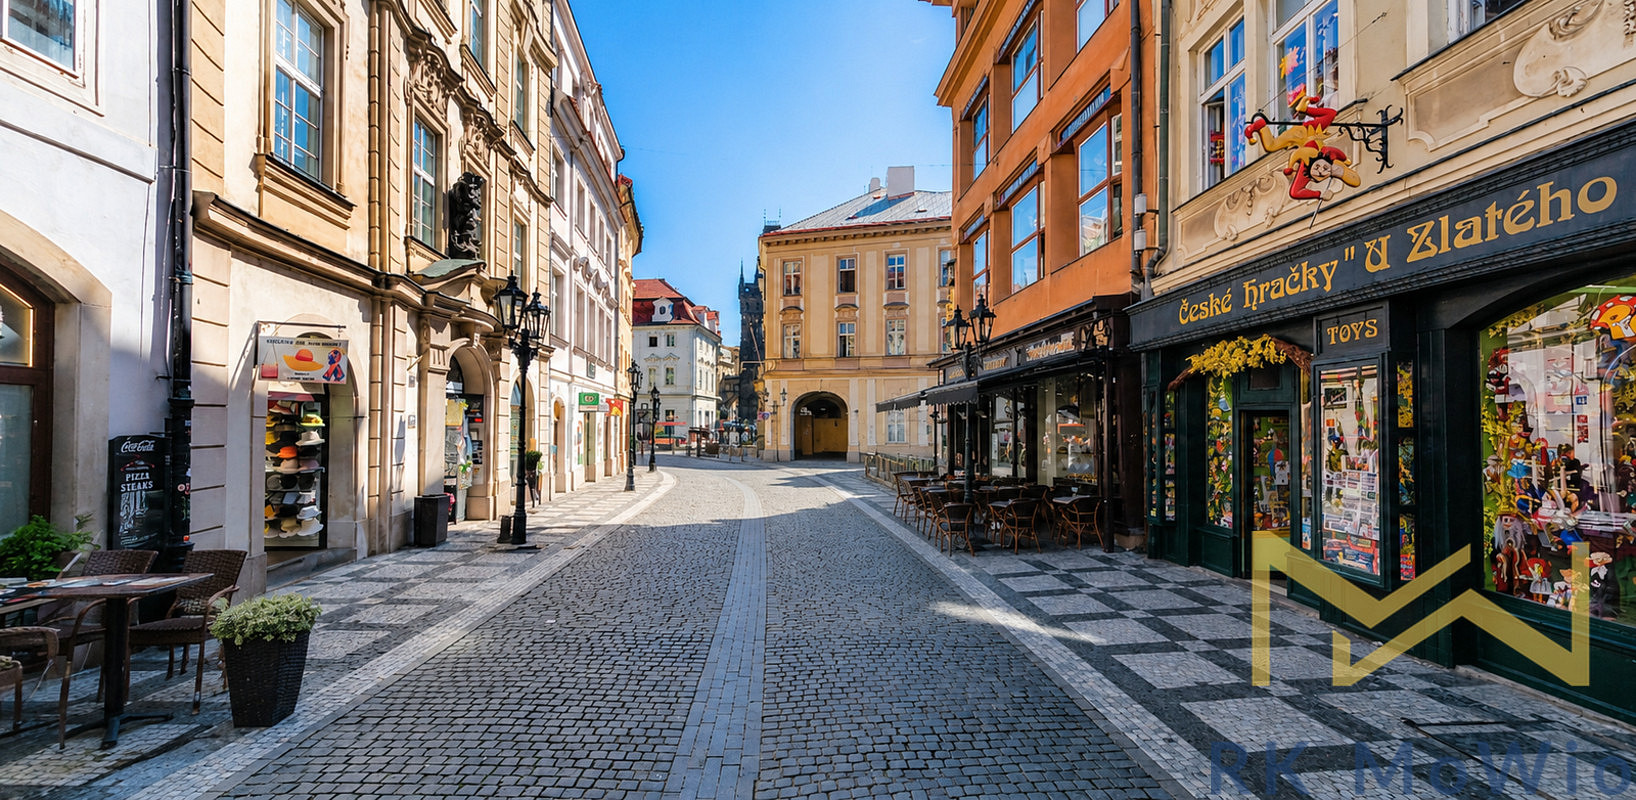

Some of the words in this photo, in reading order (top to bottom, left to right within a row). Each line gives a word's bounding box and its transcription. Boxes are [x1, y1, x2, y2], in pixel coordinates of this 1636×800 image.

[1178, 288, 1232, 325] České
[1406, 175, 1618, 263] Zlatého
[1326, 318, 1378, 345] TOYS
[120, 481, 154, 492] STEAKS
[125, 472, 150, 482] PIZZA
